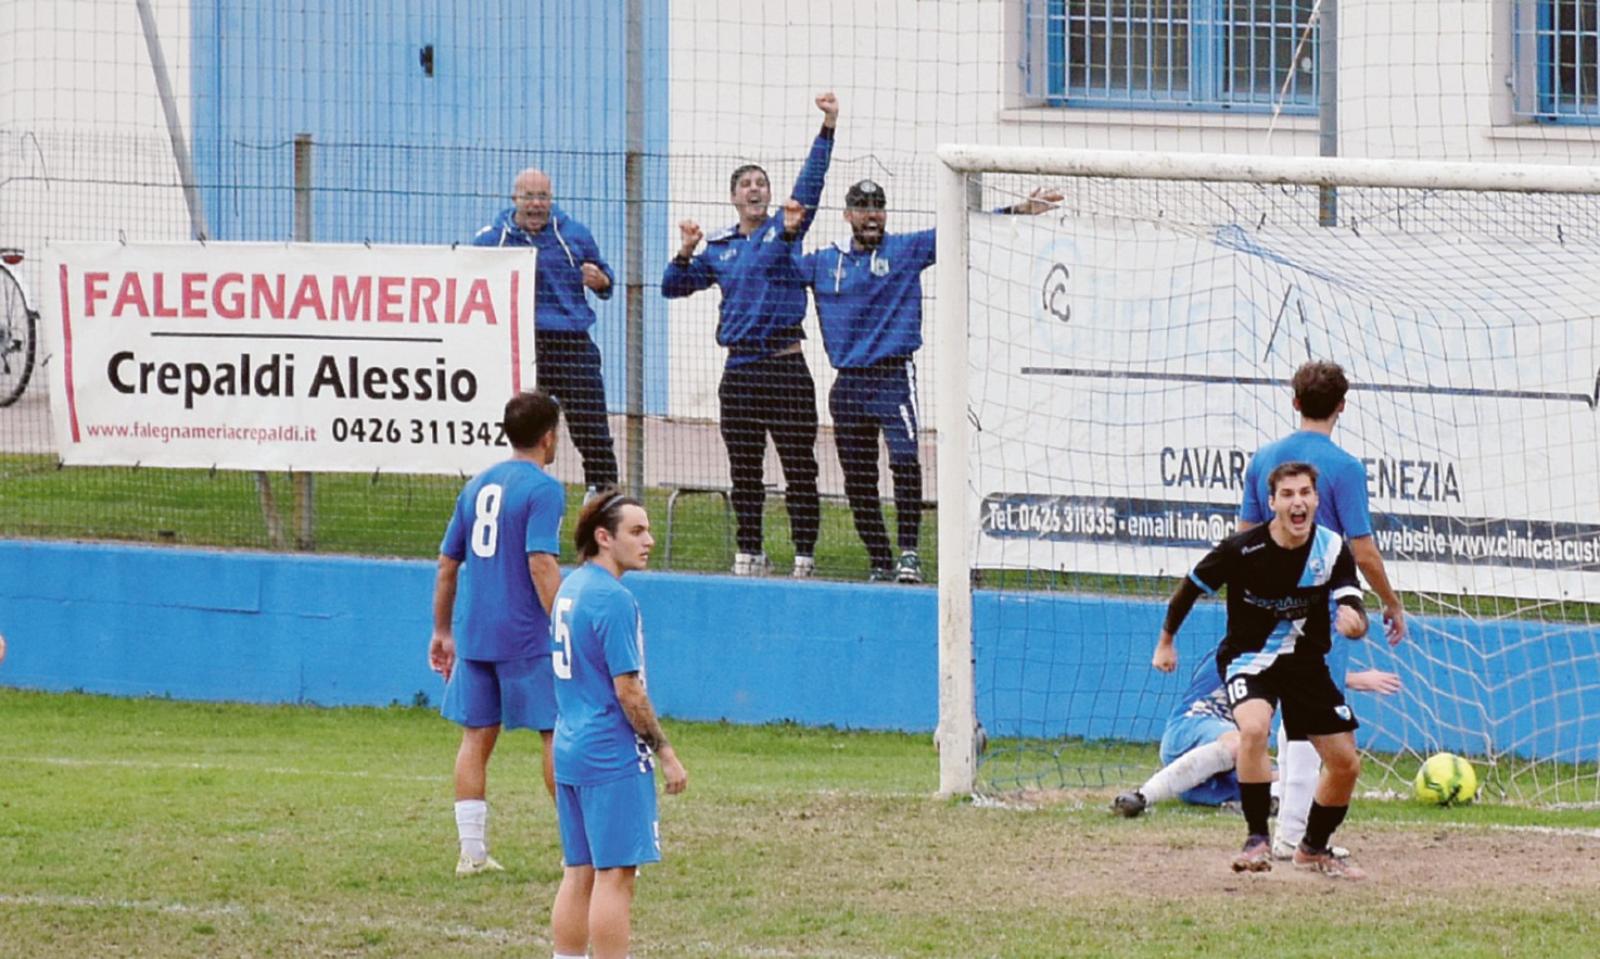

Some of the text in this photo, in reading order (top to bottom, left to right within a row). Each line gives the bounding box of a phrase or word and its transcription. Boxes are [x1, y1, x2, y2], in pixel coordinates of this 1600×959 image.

[83, 271, 498, 325] FALEGNAMERIA
[106, 350, 478, 409] Crepaldi Alessio
[87, 417, 508, 447] www.falegnameriacrepaldi.it 0426 311342
[1160, 447, 1461, 503] CAVAR ENEZIA
[472, 483, 503, 558] 8
[1128, 516, 1174, 539] email
[1376, 526, 1600, 563] website www.clinicaacust
[1228, 678, 1248, 704] 16
